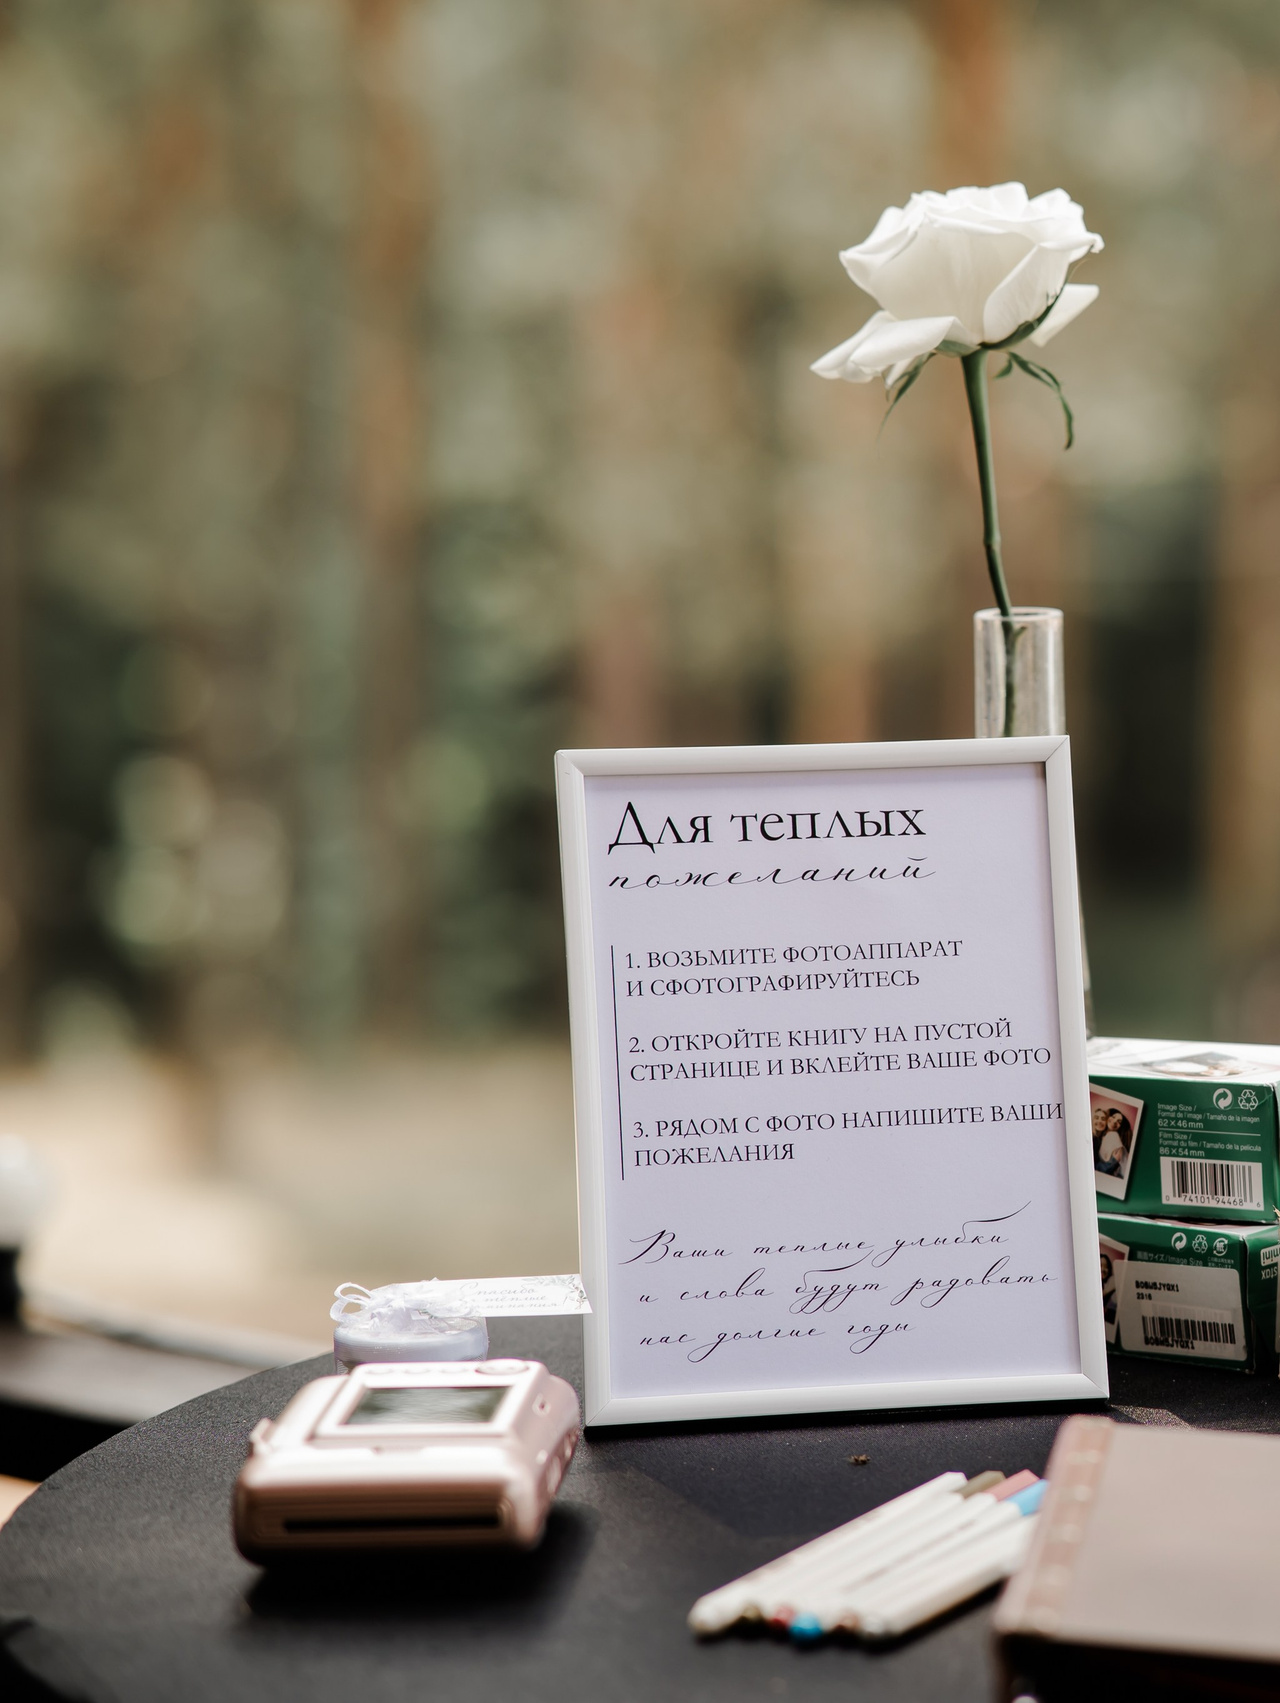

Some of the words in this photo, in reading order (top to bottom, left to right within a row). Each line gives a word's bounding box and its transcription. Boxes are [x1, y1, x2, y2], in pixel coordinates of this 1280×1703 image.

[607, 800, 714, 856] Для
[729, 808, 927, 843] теплых
[607, 856, 936, 890] пожеланий
[625, 952, 641, 969] 1.
[646, 947, 777, 969] ВОЗЬМИТЕ
[782, 939, 963, 963] ФОТОАППАРАТ
[625, 980, 645, 998] И
[650, 967, 920, 997] СФОТОГРАФИРУЙТЕСЬ
[628, 1036, 645, 1054] 2.
[651, 1028, 782, 1053] ОТКРОЙТЕ
[787, 1027, 868, 1048] КНИГУ
[873, 1025, 909, 1044] НА
[913, 1017, 1013, 1042] ПУСТОЙ
[629, 1059, 761, 1082] СТРАНИЦЕ
[766, 1058, 785, 1076] И
[789, 1051, 901, 1075] ВКЛЕЙТЕ
[905, 1050, 978, 1070] ВАШЕ
[983, 1047, 1052, 1067] ФОТО
[634, 1121, 649, 1138] 3.
[656, 1119, 738, 1138] РЯДОМ
[745, 1117, 759, 1133] С
[766, 1114, 835, 1133] ФОТО
[842, 1106, 984, 1129] НАПИШИТЕ
[991, 1103, 1063, 1122] ВАШИ
[1158, 1103, 1177, 1111] Image
[634, 1142, 796, 1167] ПОЖЕЛАНИЯ
[1183, 1195, 1210, 1204] 74101
[1215, 1197, 1243, 1206] 94468
[619, 1230, 733, 1265] Ваши
[753, 1240, 873, 1255] теплые
[871, 1201, 1032, 1267] улыбки
[640, 1292, 658, 1302] и
[679, 1268, 774, 1300] слова
[789, 1250, 888, 1314] будут
[891, 1256, 1058, 1308] радовать
[640, 1332, 696, 1346] нас
[687, 1325, 827, 1362] долгие
[847, 1321, 915, 1354] годы
